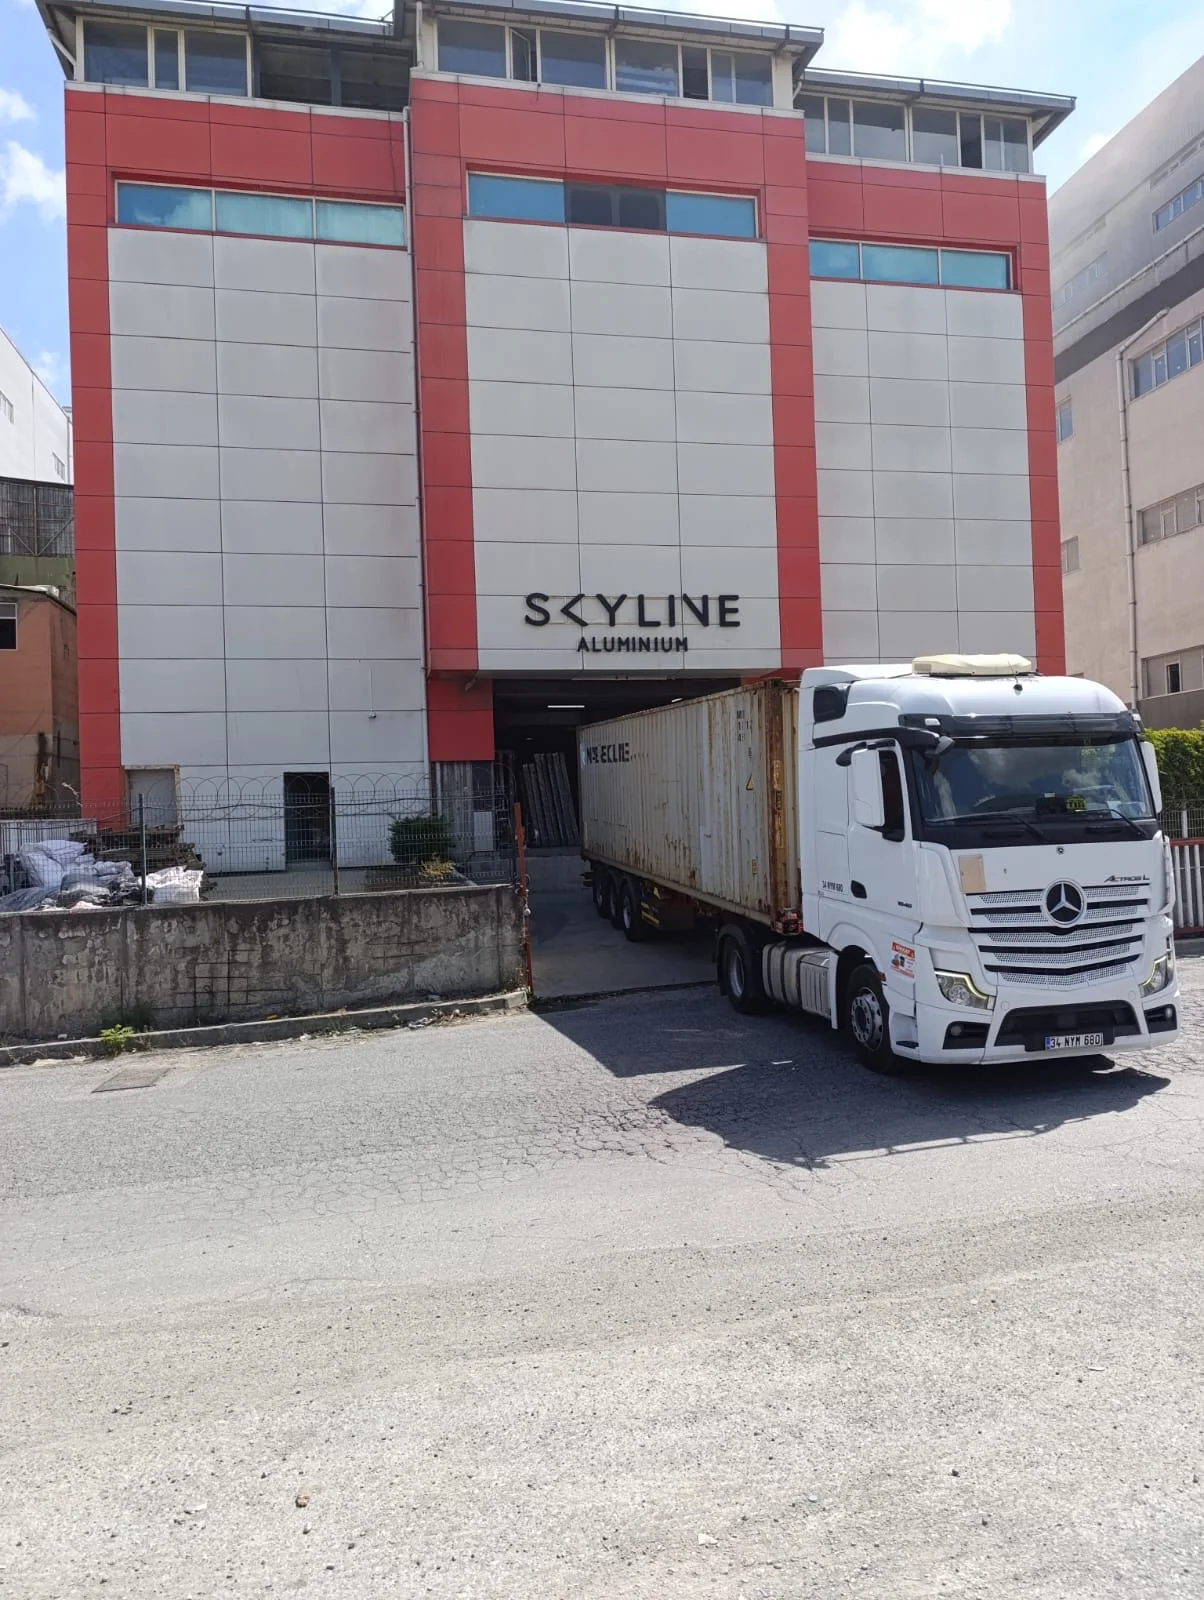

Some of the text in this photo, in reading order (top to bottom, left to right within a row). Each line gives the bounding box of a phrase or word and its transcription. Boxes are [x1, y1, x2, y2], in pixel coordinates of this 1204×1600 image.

[576, 636, 689, 652] ALUMINIUM
[1050, 1034, 1101, 1048] 34 NYM 680
